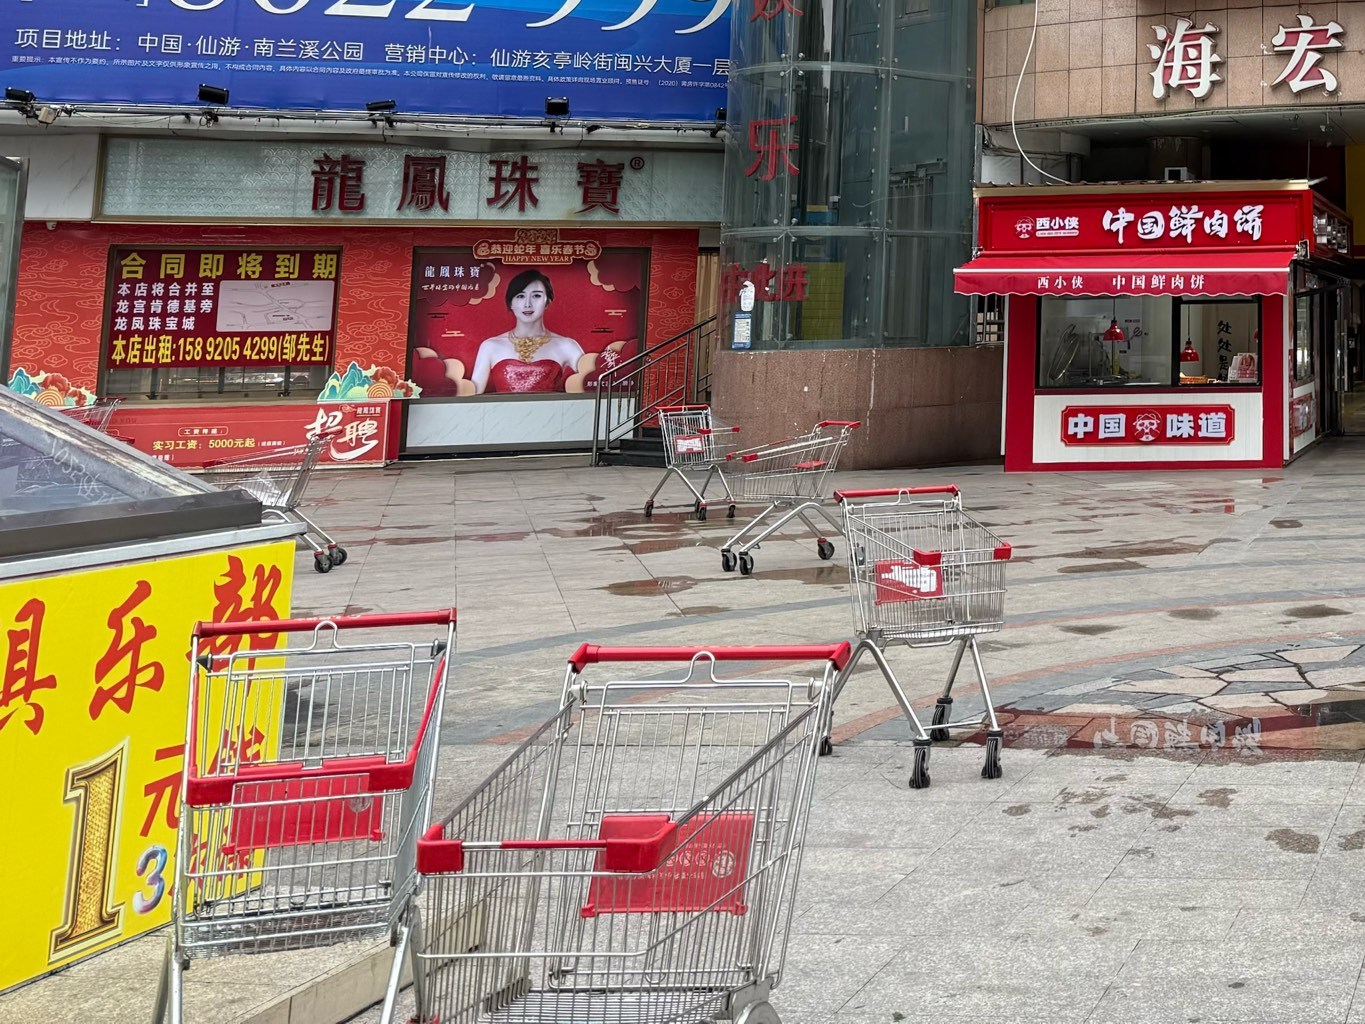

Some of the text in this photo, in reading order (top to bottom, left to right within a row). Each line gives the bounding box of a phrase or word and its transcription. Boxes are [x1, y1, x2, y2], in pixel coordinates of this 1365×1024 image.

[311, 153, 625, 214] 龍鳳珠寶
[1036, 205, 1265, 244] 西小侠 中国鲜肉饼
[490, 244, 537, 255] 恭迎蛇年
[505, 255, 570, 263] HAPPY NEW YEAR
[120, 252, 338, 280] 合同即将到期
[117, 282, 216, 297] 本店将合并至
[1037, 275, 1205, 290] 西小侠 中国鲜肉饼
[115, 299, 214, 314] 龙宫肯德基旁
[114, 316, 196, 331] 龙凤珠宝城
[206, 337, 241, 362] 9205
[1067, 412, 1227, 439] 中国 味道
[132, 844, 168, 915] 3
